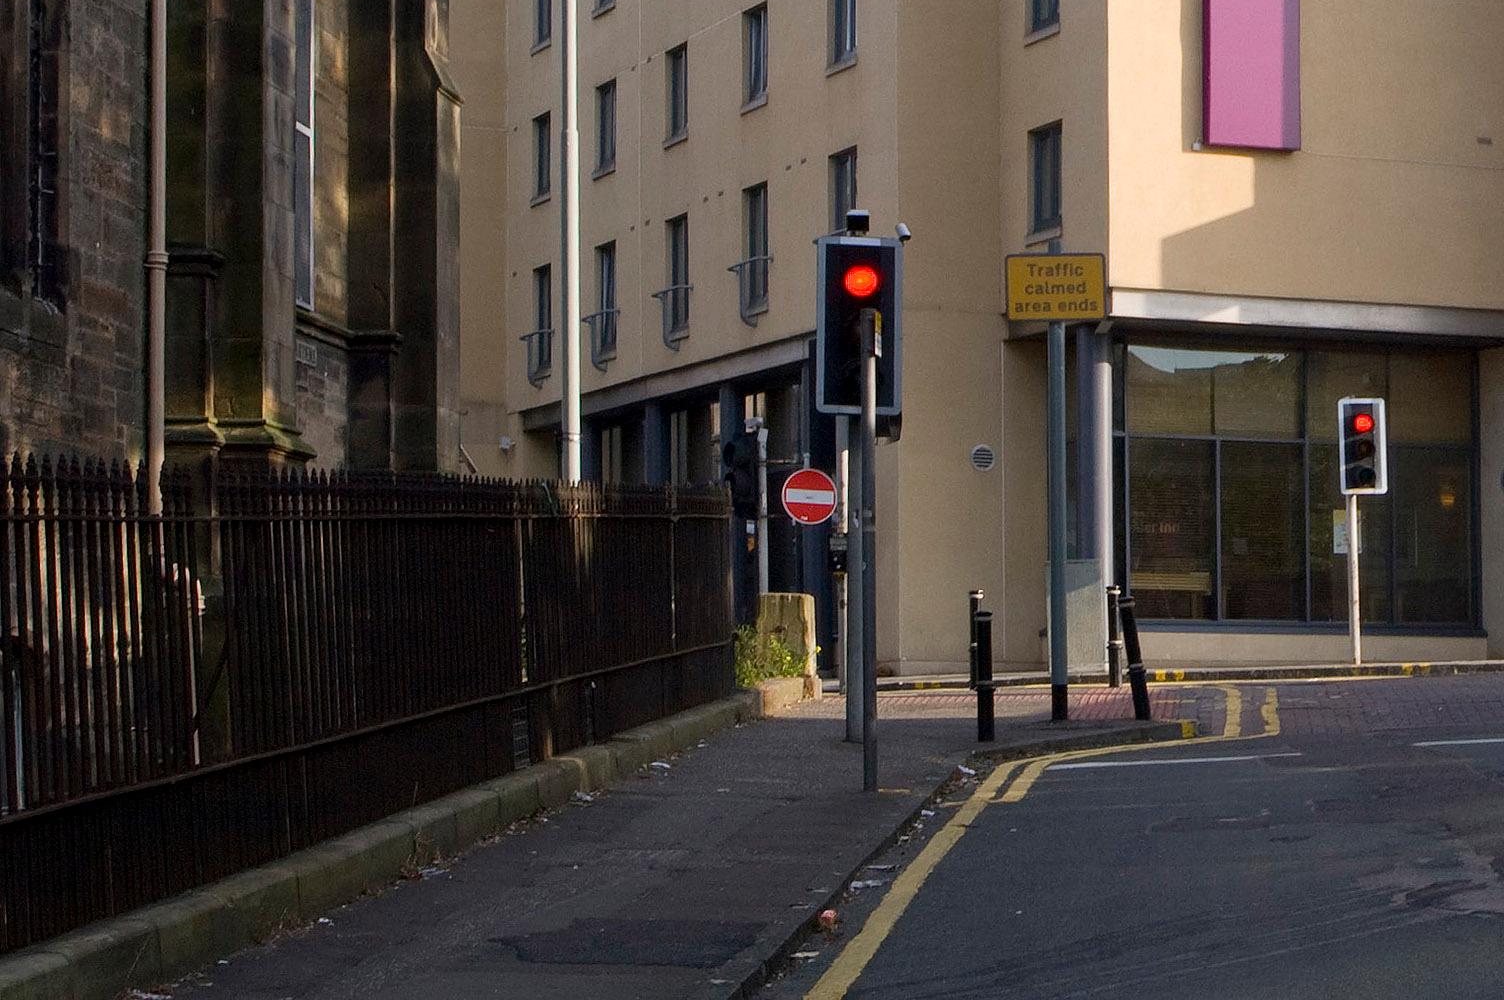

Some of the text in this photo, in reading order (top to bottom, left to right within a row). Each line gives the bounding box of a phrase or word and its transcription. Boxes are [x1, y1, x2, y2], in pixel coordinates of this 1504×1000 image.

[1027, 263, 1084, 277] Traffic
[1025, 281, 1087, 295] calmed
[1015, 299, 1098, 313] area ends
